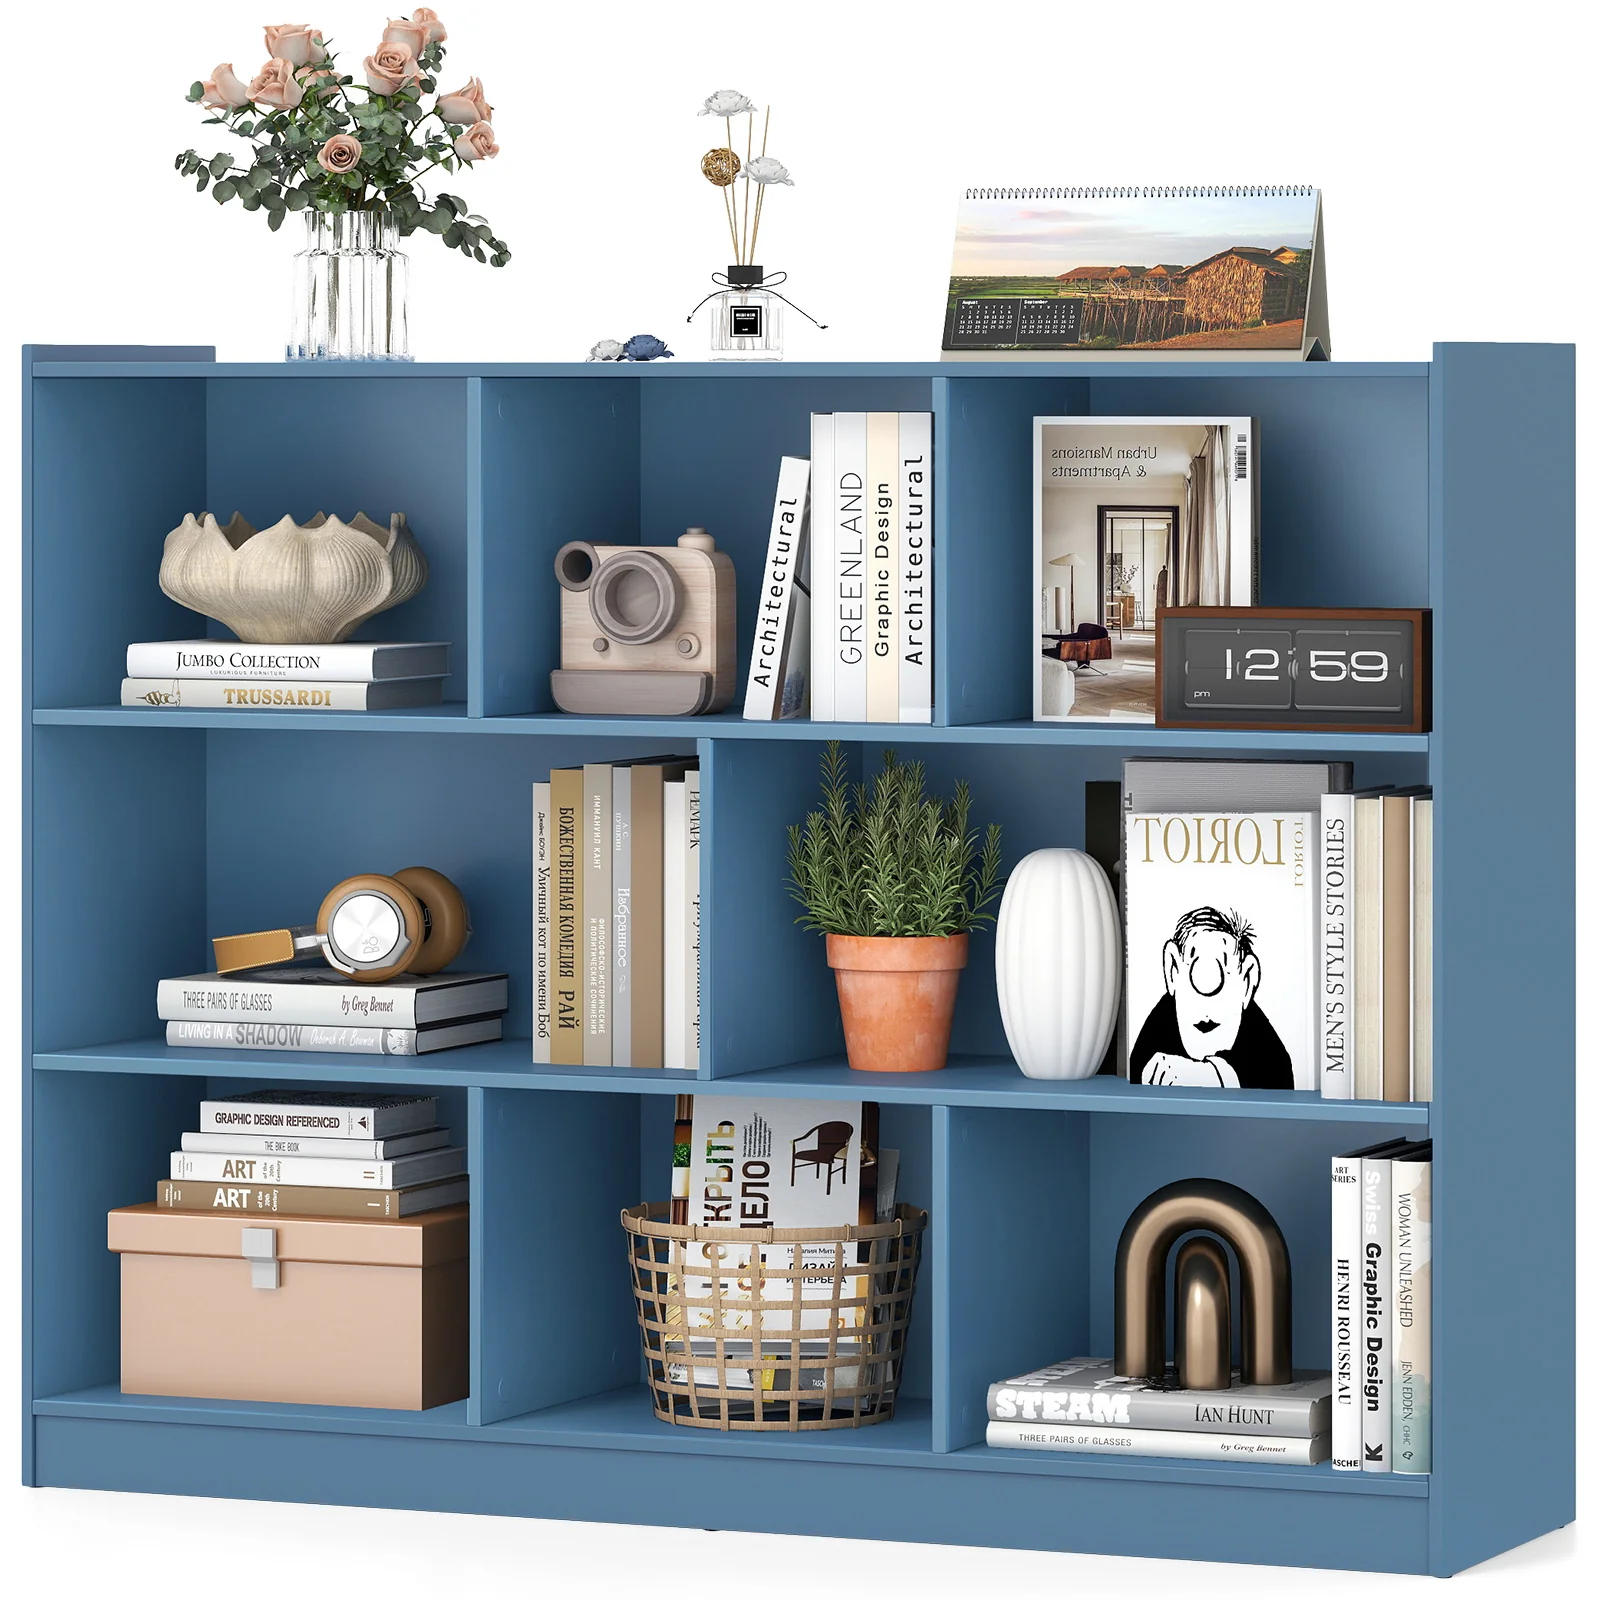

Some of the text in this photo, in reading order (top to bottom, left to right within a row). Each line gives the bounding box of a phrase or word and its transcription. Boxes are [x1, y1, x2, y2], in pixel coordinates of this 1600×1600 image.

[840, 472, 862, 664] GREENLAND
[874, 482, 892, 657] Graphic Design
[904, 455, 923, 666] Architectural
[754, 498, 798, 688] Architectural
[176, 651, 321, 671] JUMBO COLLECTION
[1224, 648, 1389, 683] 12 59
[223, 688, 332, 707] TRUSSARDI
[1193, 690, 1211, 699] pm
[593, 795, 601, 870] ИММАНУИЛ КАНТ
[557, 807, 580, 1029] БОЖЕСТВЕННАЯ КОМЕДИЯ РАЙ
[614, 888, 630, 967] Избранное
[538, 866, 550, 1038] Уличный кот по имени Боб
[1326, 818, 1345, 1073] MEN'S STYLE STORIES
[183, 990, 273, 1012] THREE PAIRS OF GLASSES
[342, 995, 394, 1015] by Greg Bennet
[178, 1021, 234, 1040] LIVING IN A
[235, 1023, 303, 1047] SHADOW
[215, 1112, 251, 1126] GRAPHIC
[254, 1113, 284, 1127] DESIGN
[286, 1114, 340, 1129] REFERENCED
[264, 1141, 300, 1152] THE BIKE BOOK
[222, 1160, 256, 1179] ART
[1334, 1166, 1350, 1174] ART
[212, 1188, 252, 1208] ART
[1398, 1193, 1413, 1328] WOMAN UNLEASHED
[1364, 1170, 1384, 1412] Swiss Graphic Design
[1337, 1259, 1351, 1405] HENRI ROUSSEAU
[1400, 1360, 1412, 1384] JENN
[995, 1388, 1275, 1426] STEAM IAN HUNT
[1402, 1386, 1413, 1422] EDDEN,
[1018, 1433, 1132, 1447] THREE PAIRS OF GLASSES
[1220, 1442, 1287, 1454] by Greg Bennet
